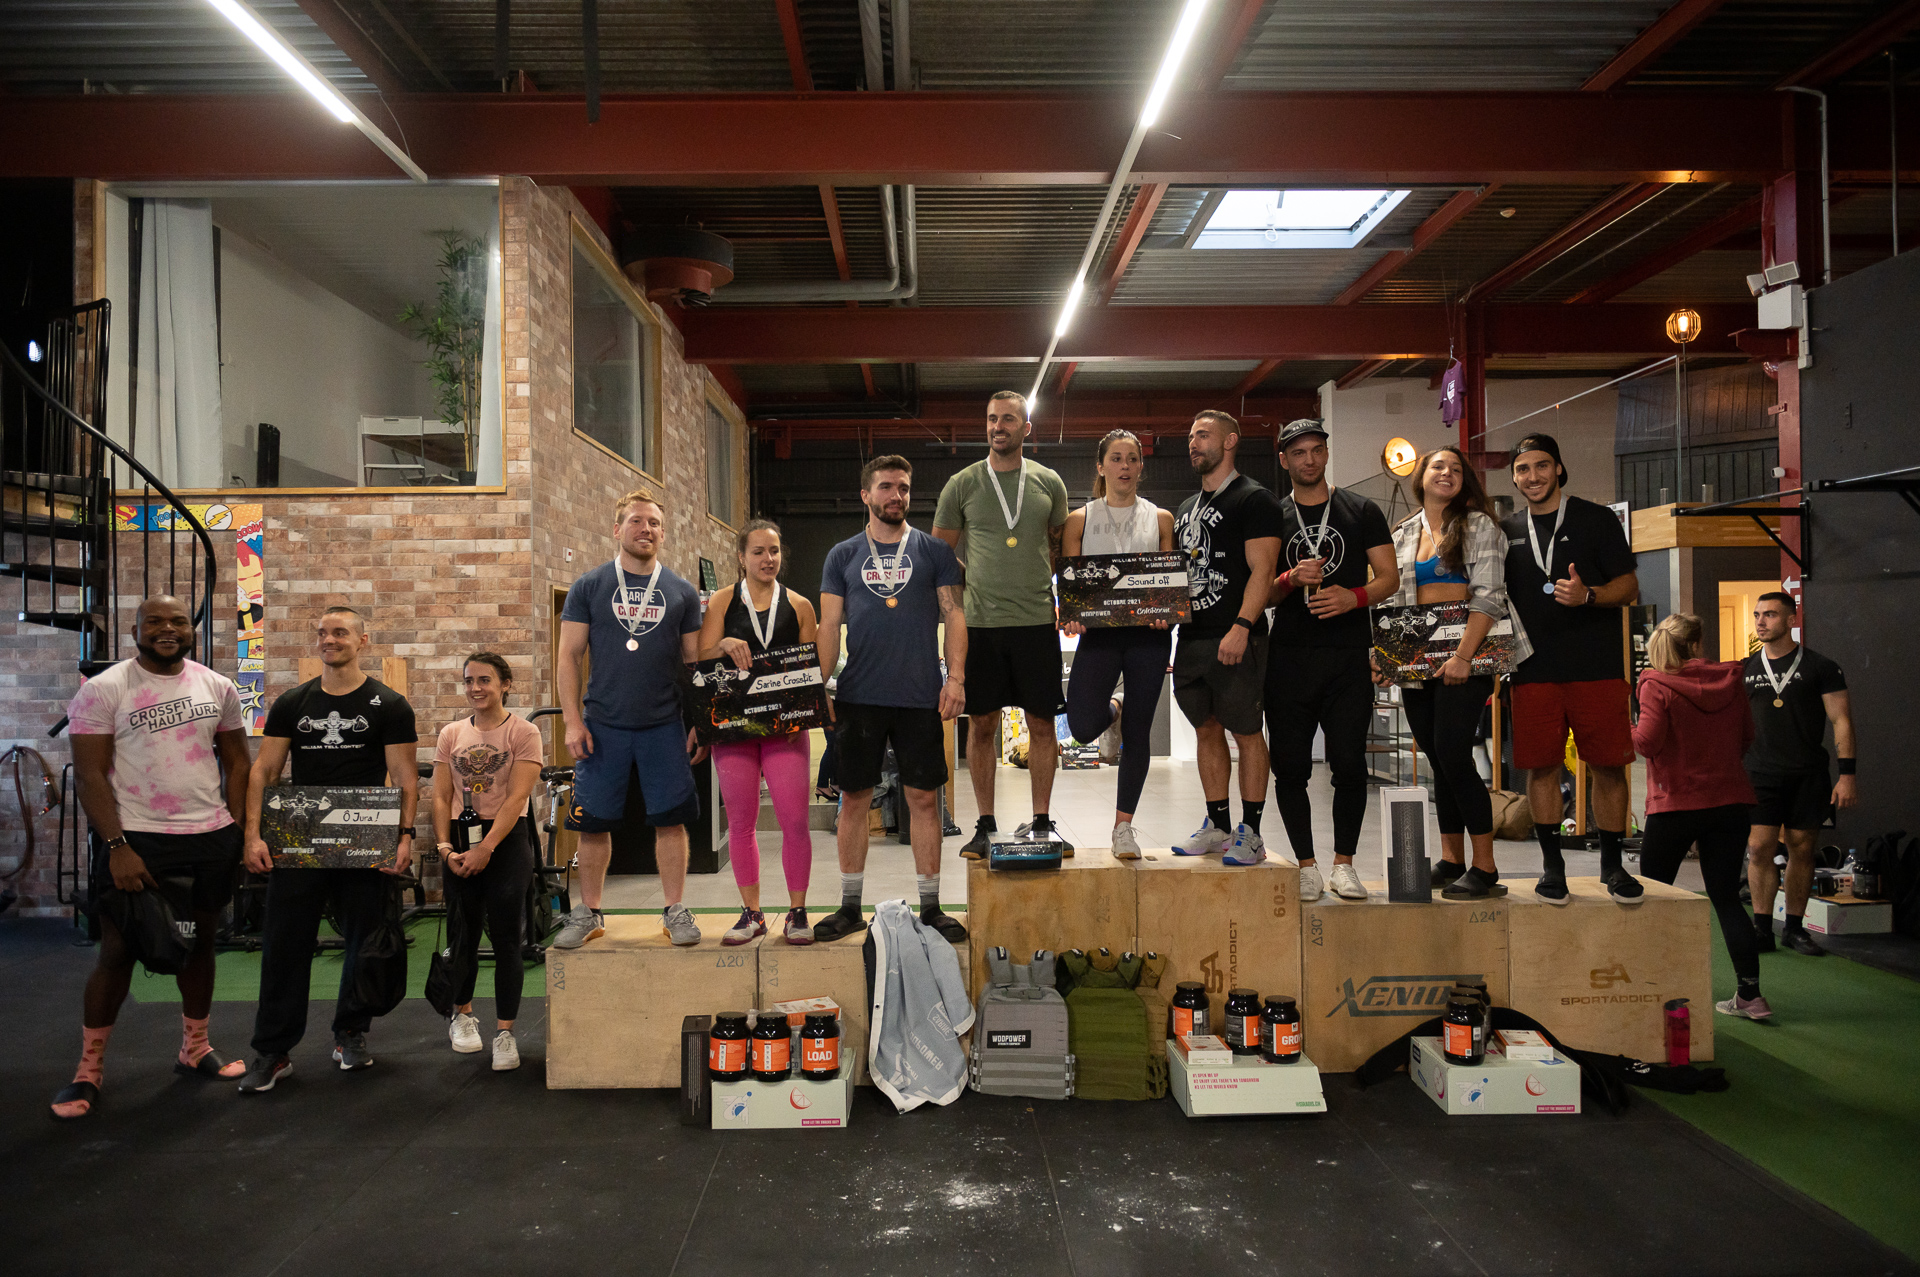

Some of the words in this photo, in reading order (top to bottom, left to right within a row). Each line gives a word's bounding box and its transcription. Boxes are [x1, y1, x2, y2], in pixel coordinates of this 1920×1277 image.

[1173, 506, 1224, 533] SAGE
[1127, 576, 1155, 586] Sound
[1158, 575, 1170, 585] off
[1440, 627, 1461, 638] Team
[752, 653, 770, 661] LIAM
[786, 643, 815, 654] CONTEST
[1424, 651, 1449, 659] OCTOBRE
[755, 680, 782, 690] Sarine
[783, 673, 813, 685] Crossfit
[129, 698, 193, 727] CROSSFIT
[148, 711, 183, 730] HAUT
[188, 704, 218, 719] JURA
[744, 705, 768, 715] OCTOBRE
[768, 703, 782, 711] 2021
[342, 809, 351, 822] Ô
[353, 812, 373, 822] Jura
[1404, 824, 1413, 871] COMPEX
[1273, 894, 1286, 918] 60
[1229, 919, 1238, 989] RTADDICT
[1325, 976, 1456, 1018] XENIO
[1560, 994, 1663, 1006] SPORTADDICT
[992, 1034, 1026, 1043] WODPOWER
[807, 1050, 833, 1061] LOAD
